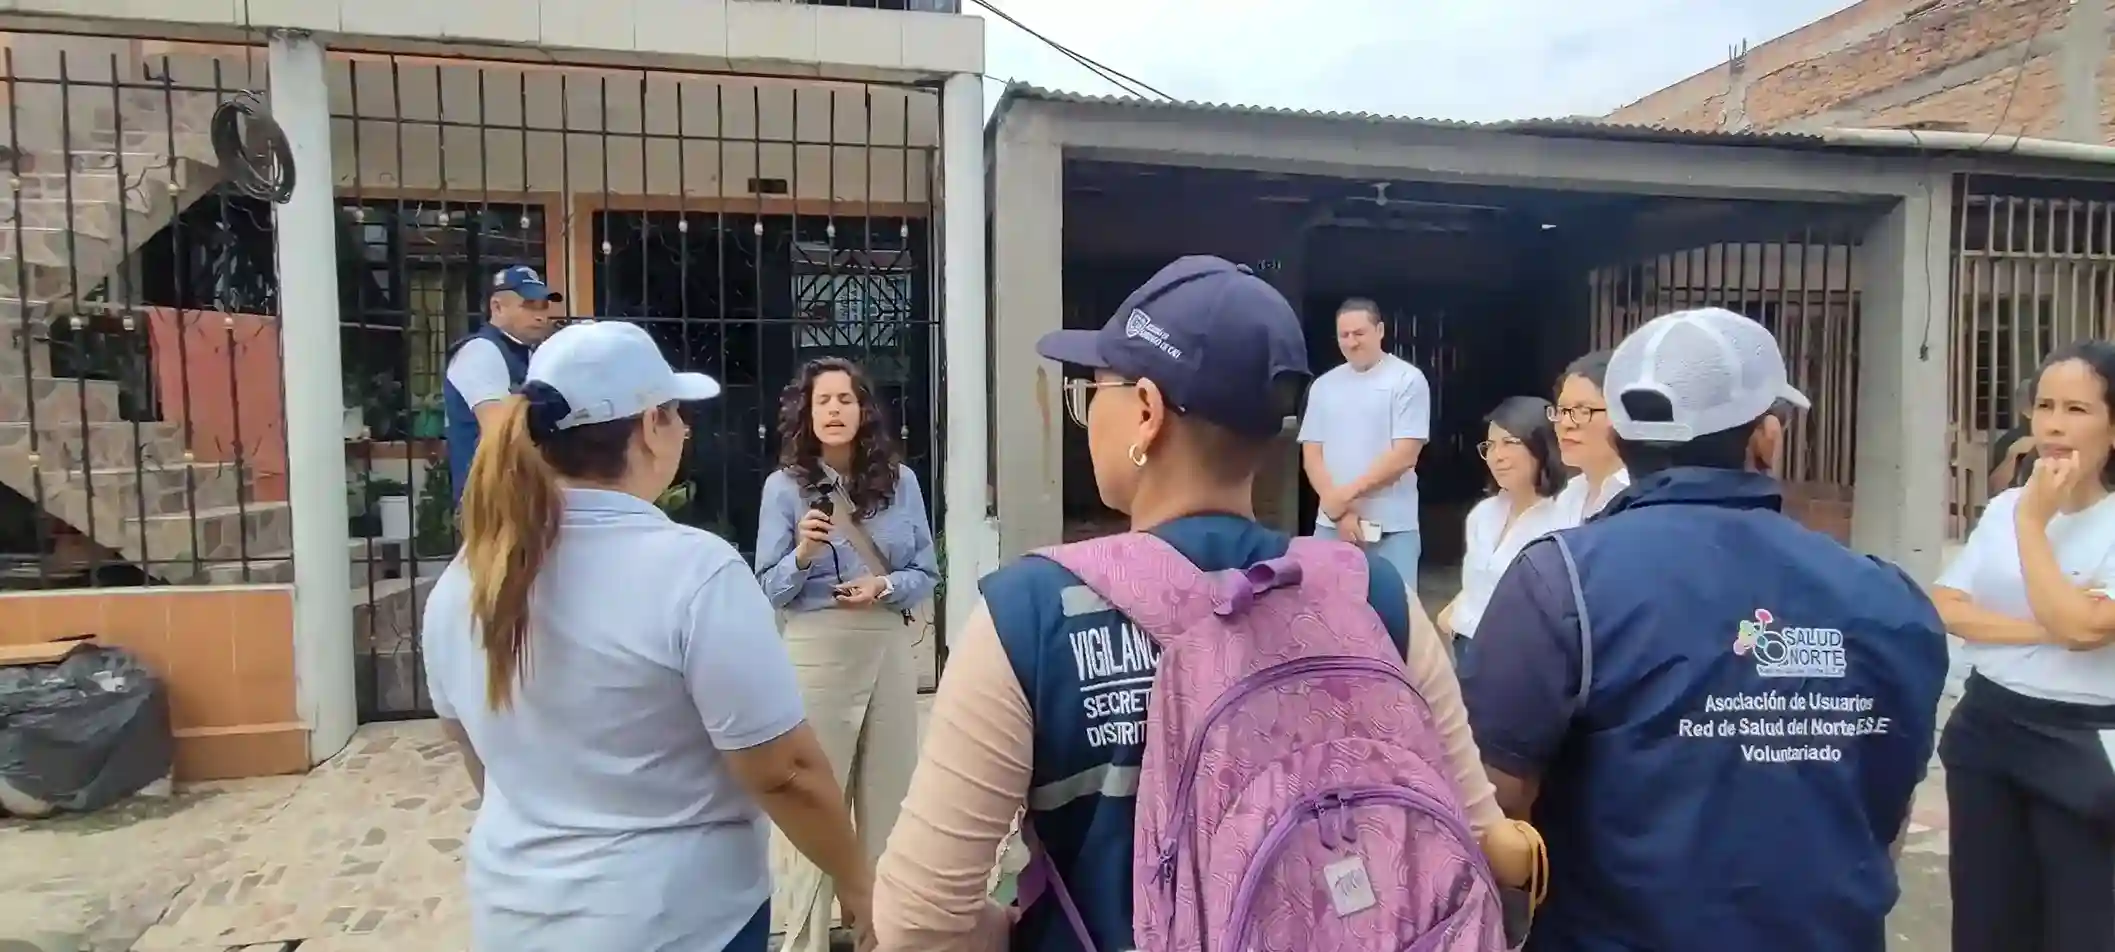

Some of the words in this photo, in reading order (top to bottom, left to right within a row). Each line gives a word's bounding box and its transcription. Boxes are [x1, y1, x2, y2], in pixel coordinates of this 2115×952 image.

[1783, 627, 1843, 647] SALUD
[1788, 648, 1846, 667] NORTE
[1083, 688, 1153, 719] SECRET
[1705, 690, 1786, 712] Asociación
[1789, 692, 1806, 711] de
[1809, 692, 1874, 712] Usuarios
[1086, 720, 1147, 747] DISTRIT
[1679, 718, 1714, 737] Red
[1718, 718, 1735, 736] de
[1739, 717, 1785, 736] Salud
[1787, 718, 1808, 736] del
[1811, 717, 1856, 737] Norte
[1740, 744, 1842, 763] Voluntariado
